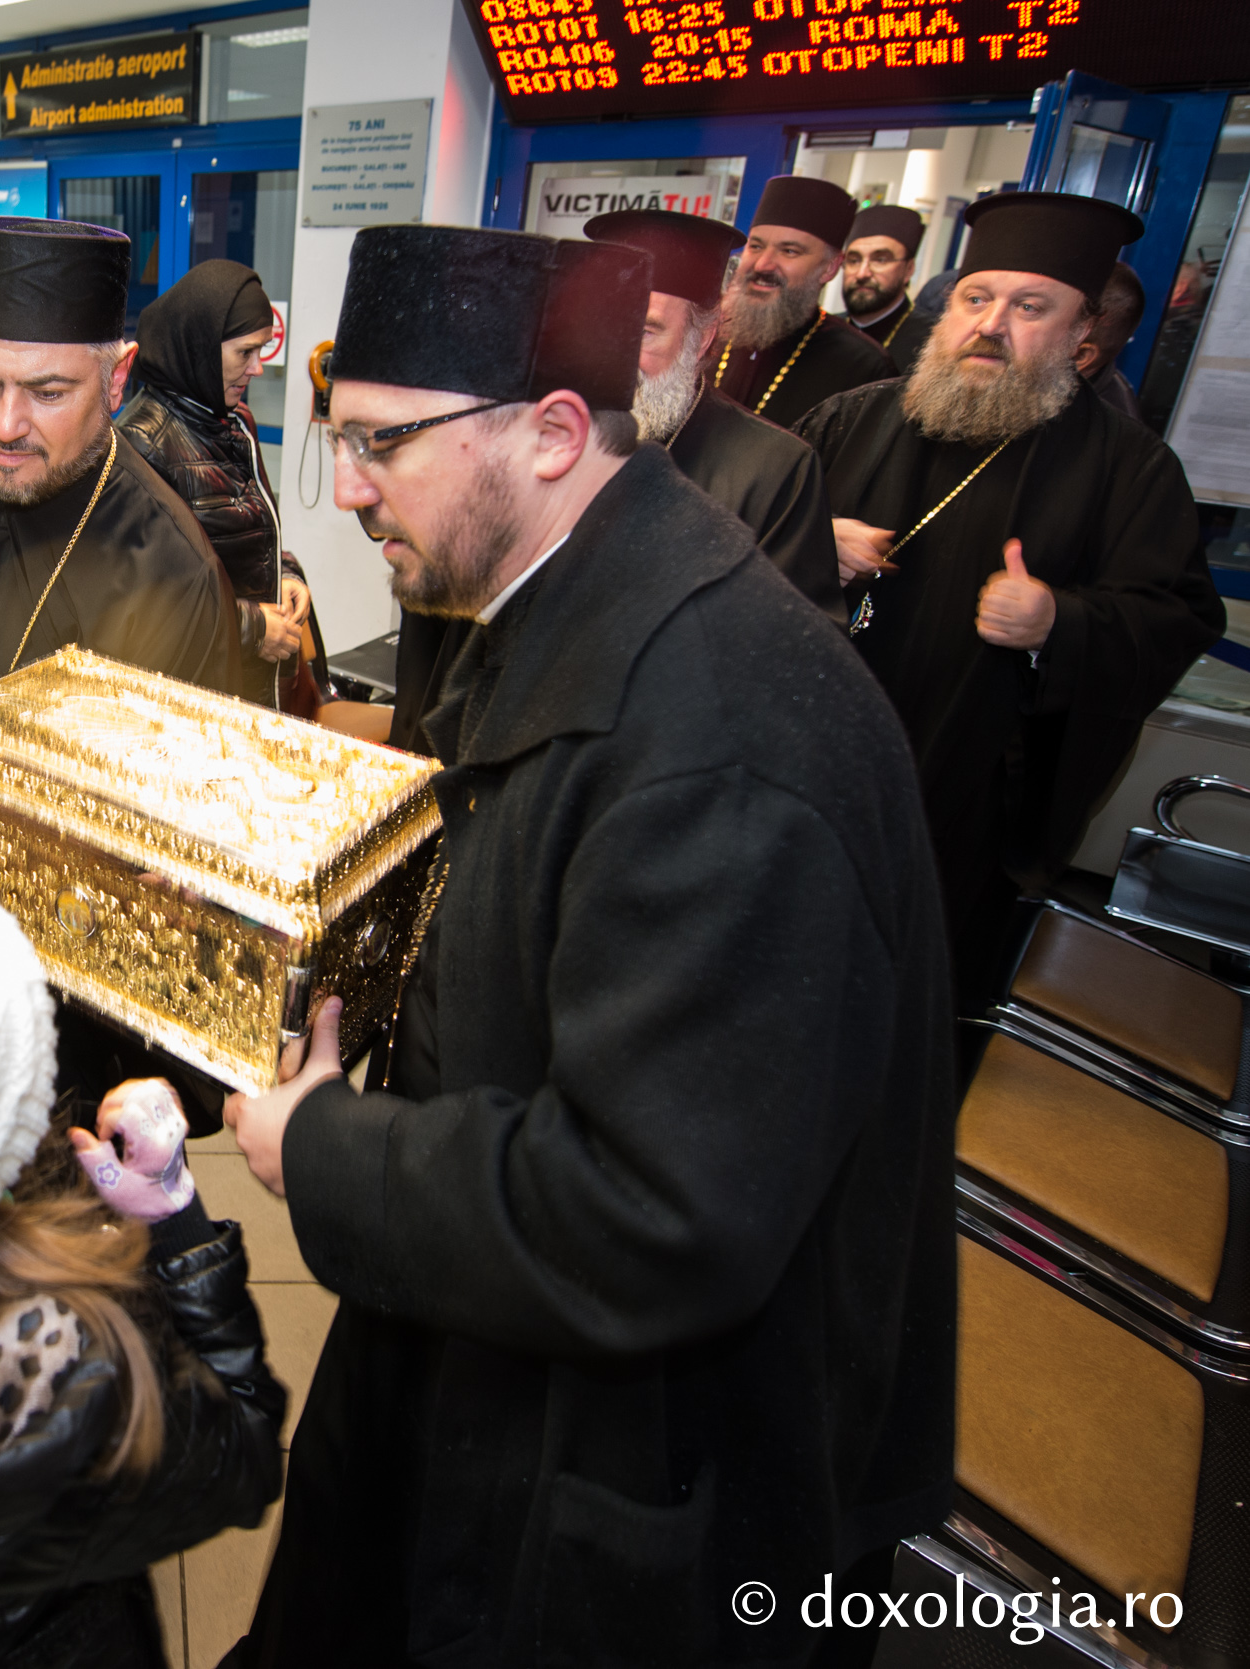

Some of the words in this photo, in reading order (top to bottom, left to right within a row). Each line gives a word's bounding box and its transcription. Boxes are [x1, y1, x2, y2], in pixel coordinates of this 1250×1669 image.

[488, 14, 599, 48] RO707
[624, 0, 725, 34] 18:25
[497, 40, 616, 72] RO406
[650, 26, 753, 59] 20:15
[808, 8, 961, 45] ROMA
[21, 54, 114, 89] Administratie
[117, 43, 186, 79] aeroport
[505, 66, 619, 95] RO709
[641, 54, 748, 85] 22:45
[978, 31, 1048, 60] T2
[30, 104, 76, 130] Airport
[78, 94, 184, 123] administration
[348, 120, 361, 131] 75
[365, 118, 385, 130] ANI
